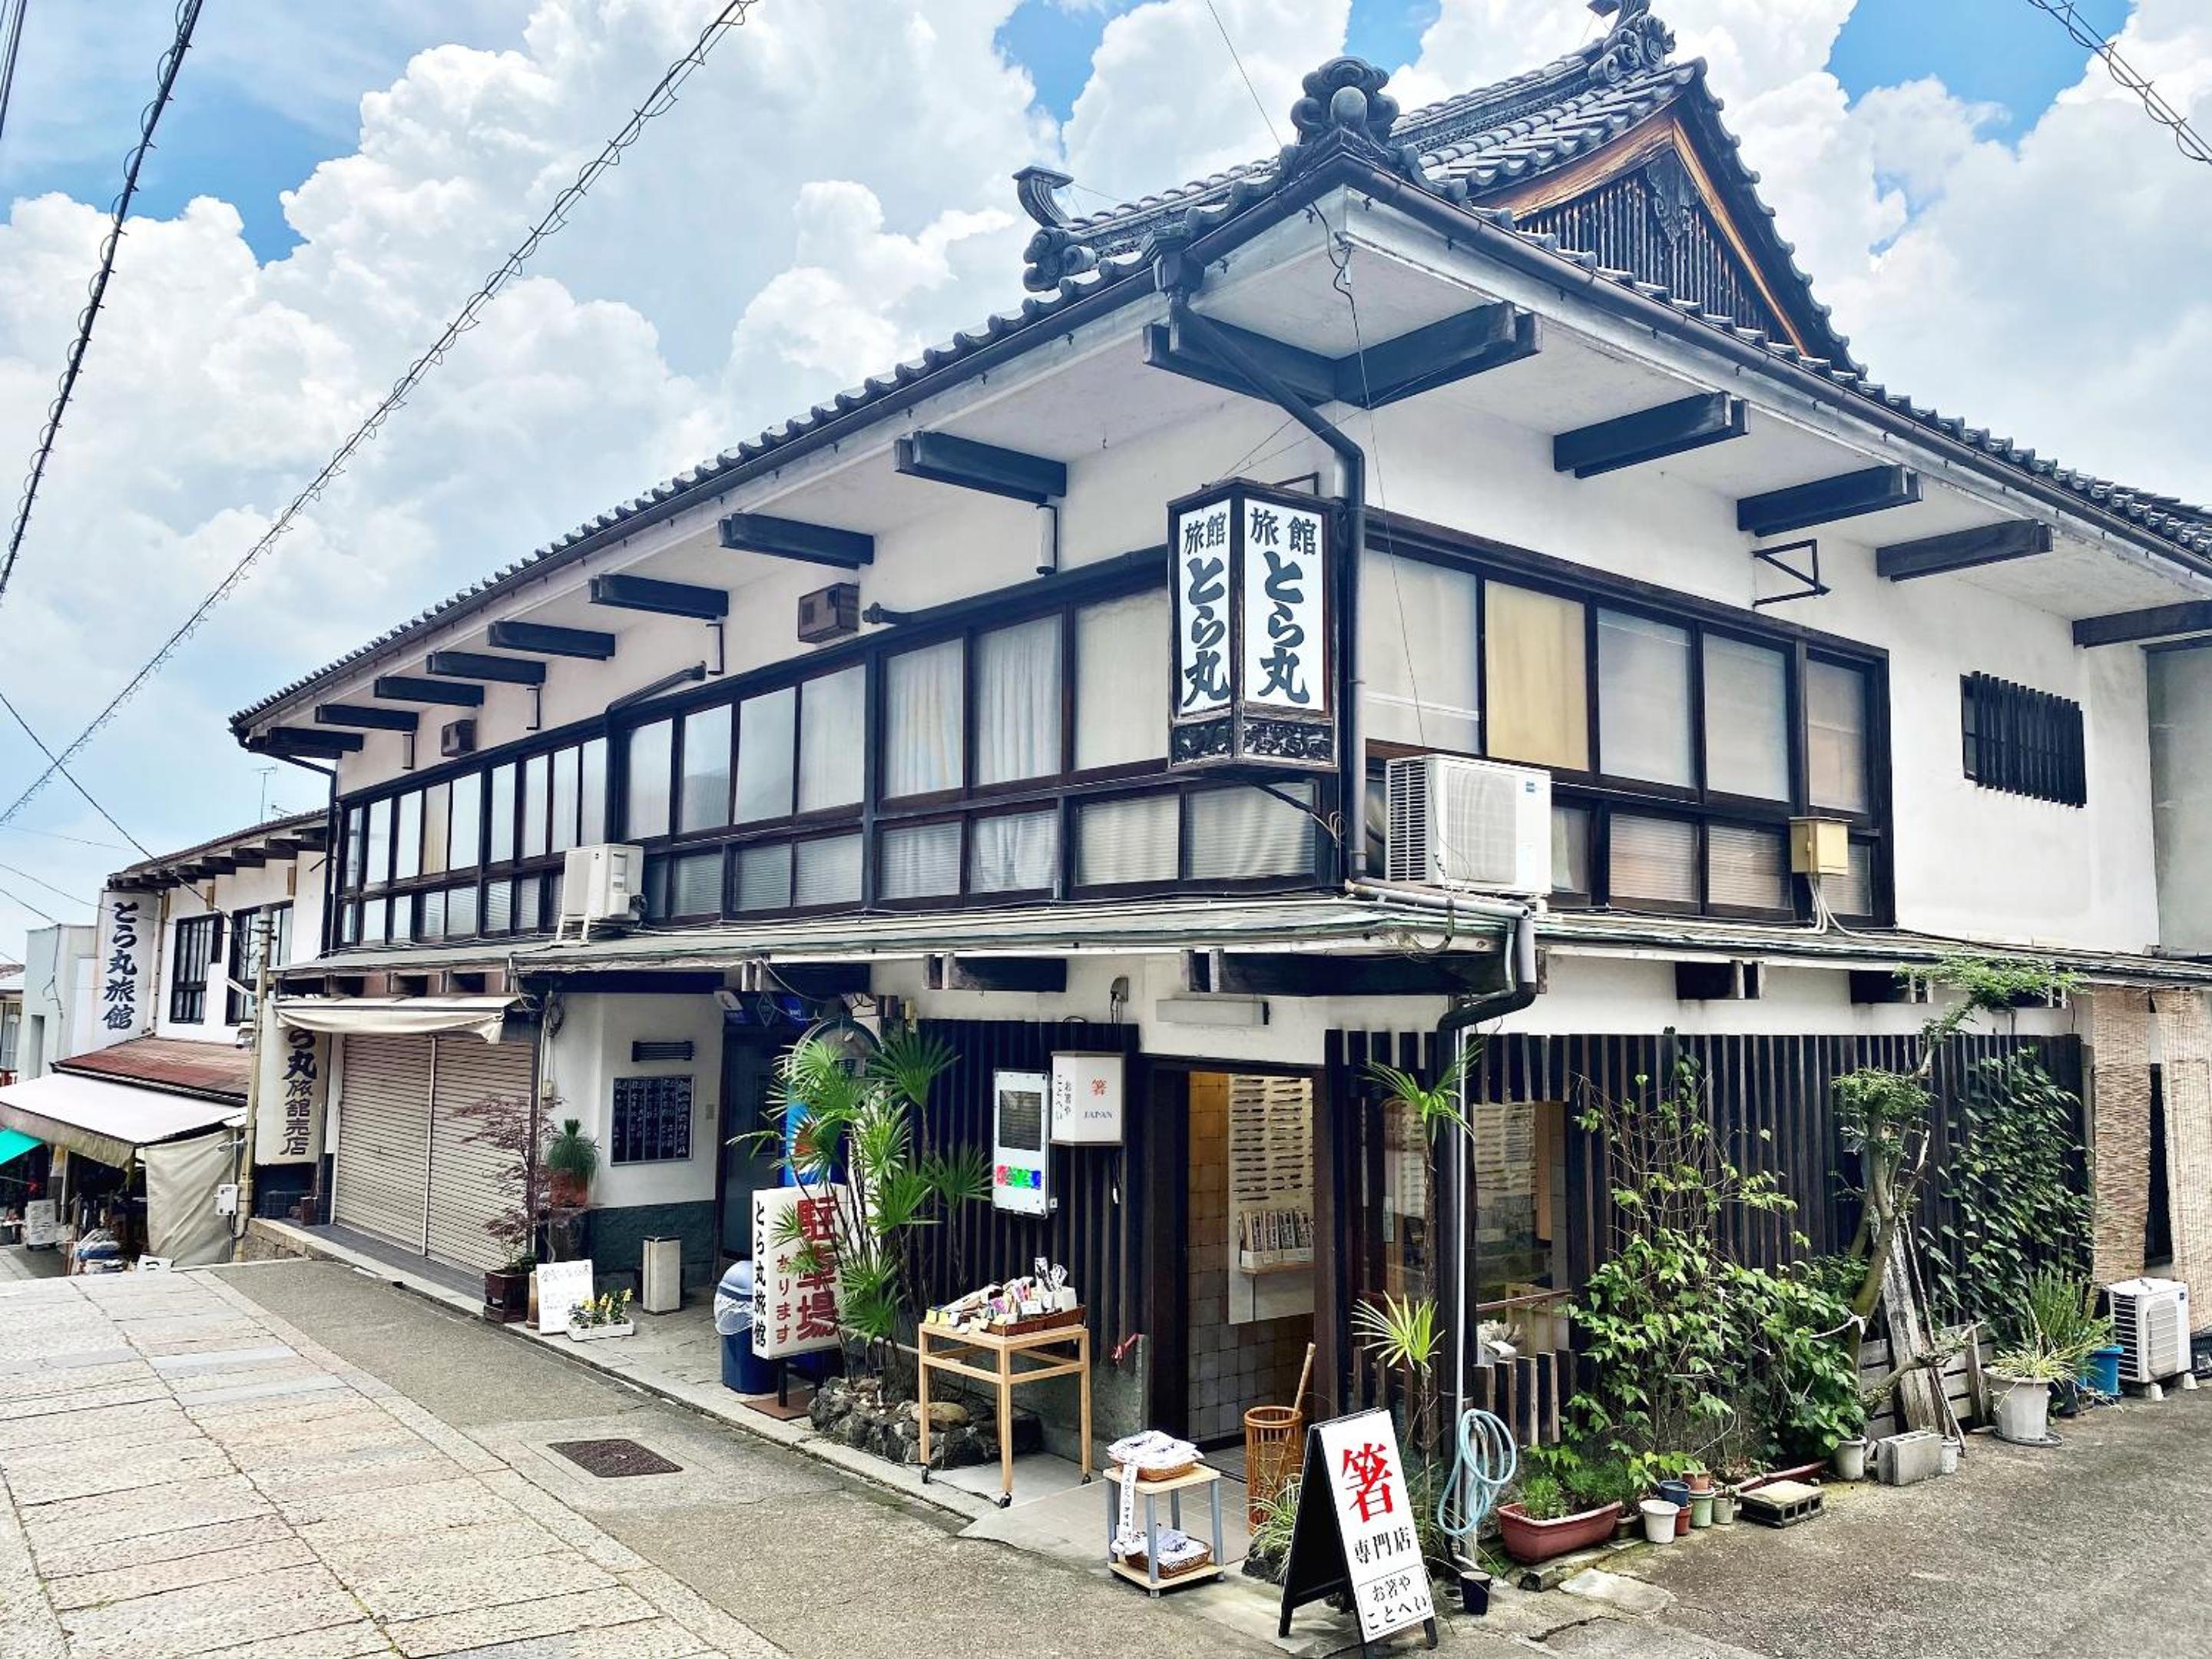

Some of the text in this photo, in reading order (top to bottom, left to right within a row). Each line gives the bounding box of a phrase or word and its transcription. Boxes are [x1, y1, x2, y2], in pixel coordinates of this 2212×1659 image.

[1184, 512, 1227, 555] 旅館
[1250, 507, 1317, 555] 旅館
[1183, 556, 1230, 707] とら丸
[1257, 551, 1310, 704] とら丸
[101, 902, 140, 1030] とら丸旅館
[1084, 1111, 1113, 1119] JAPAN
[754, 1200, 767, 1348] とら丸旅館
[1342, 1442, 1393, 1522] 箸
[1354, 1527, 1412, 1564] 専門店
[1367, 1595, 1427, 1630] ことへい
[1372, 1574, 1411, 1603] お箸や
